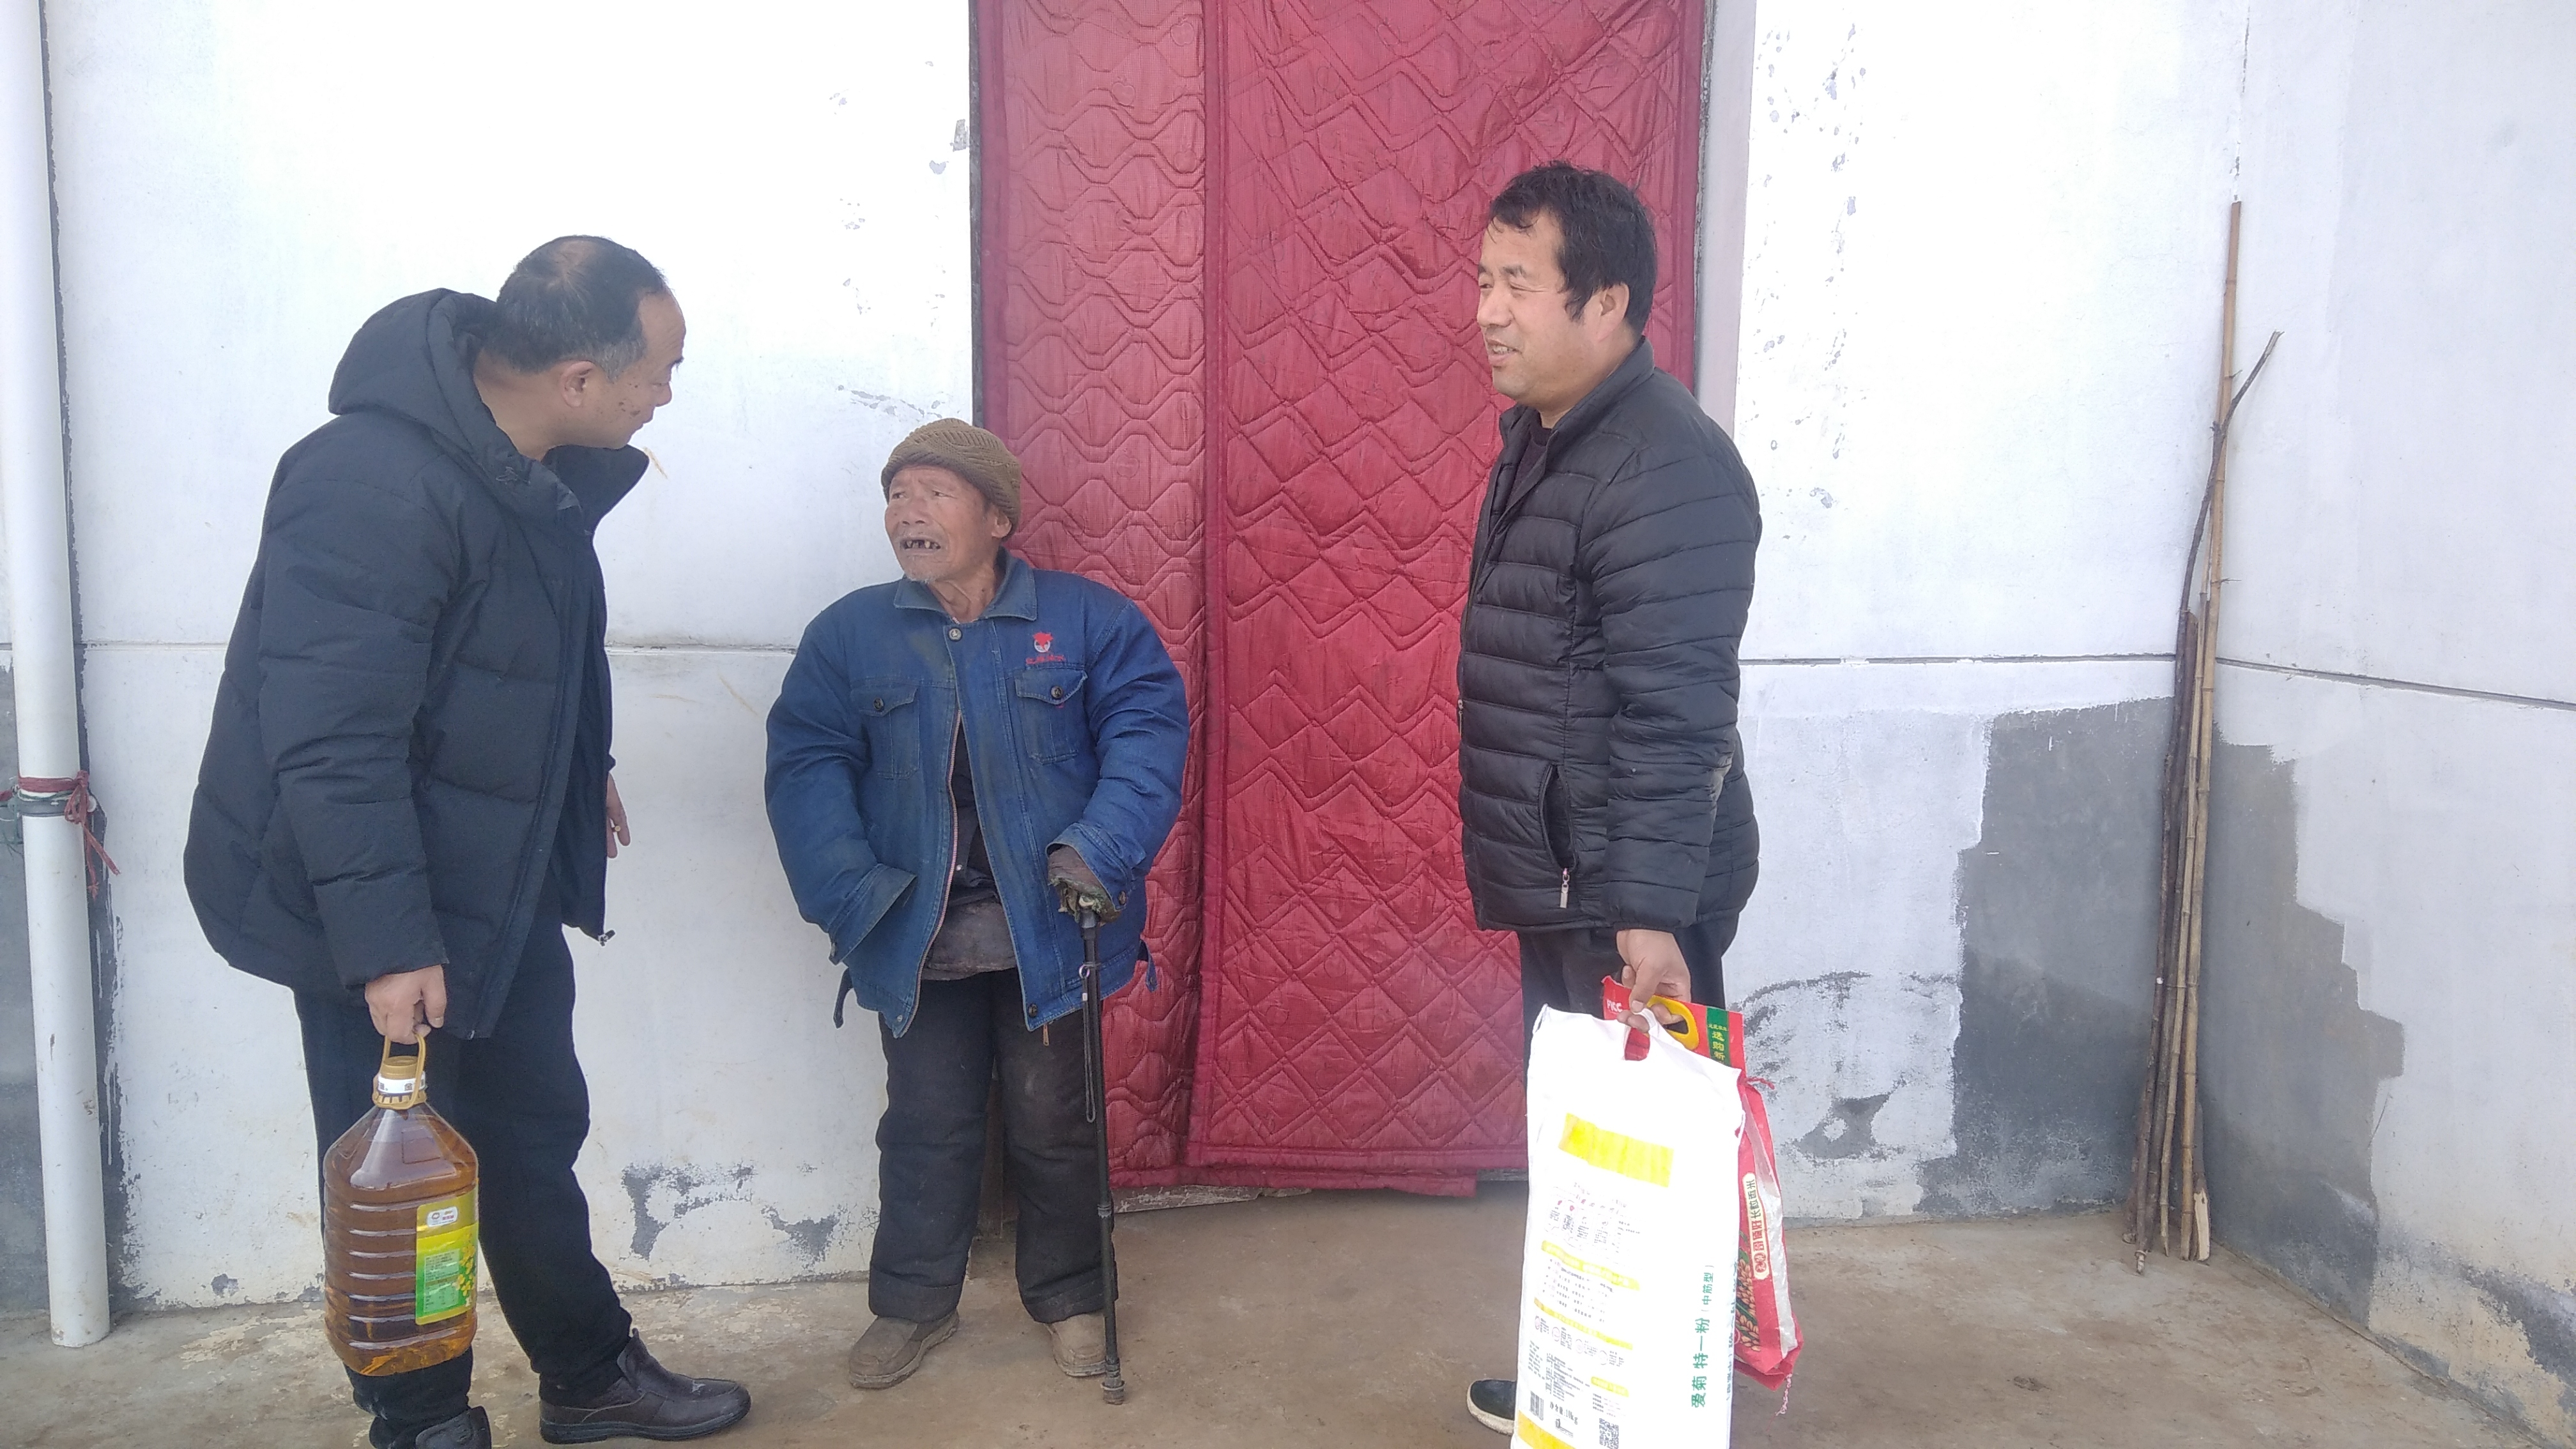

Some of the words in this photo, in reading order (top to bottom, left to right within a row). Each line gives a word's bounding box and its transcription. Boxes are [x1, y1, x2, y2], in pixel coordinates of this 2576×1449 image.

[1712, 1031, 1726, 1064] 选购新
[1693, 1317, 1710, 1368] 特一粉
[1691, 1375, 1707, 1408] 爱菊
